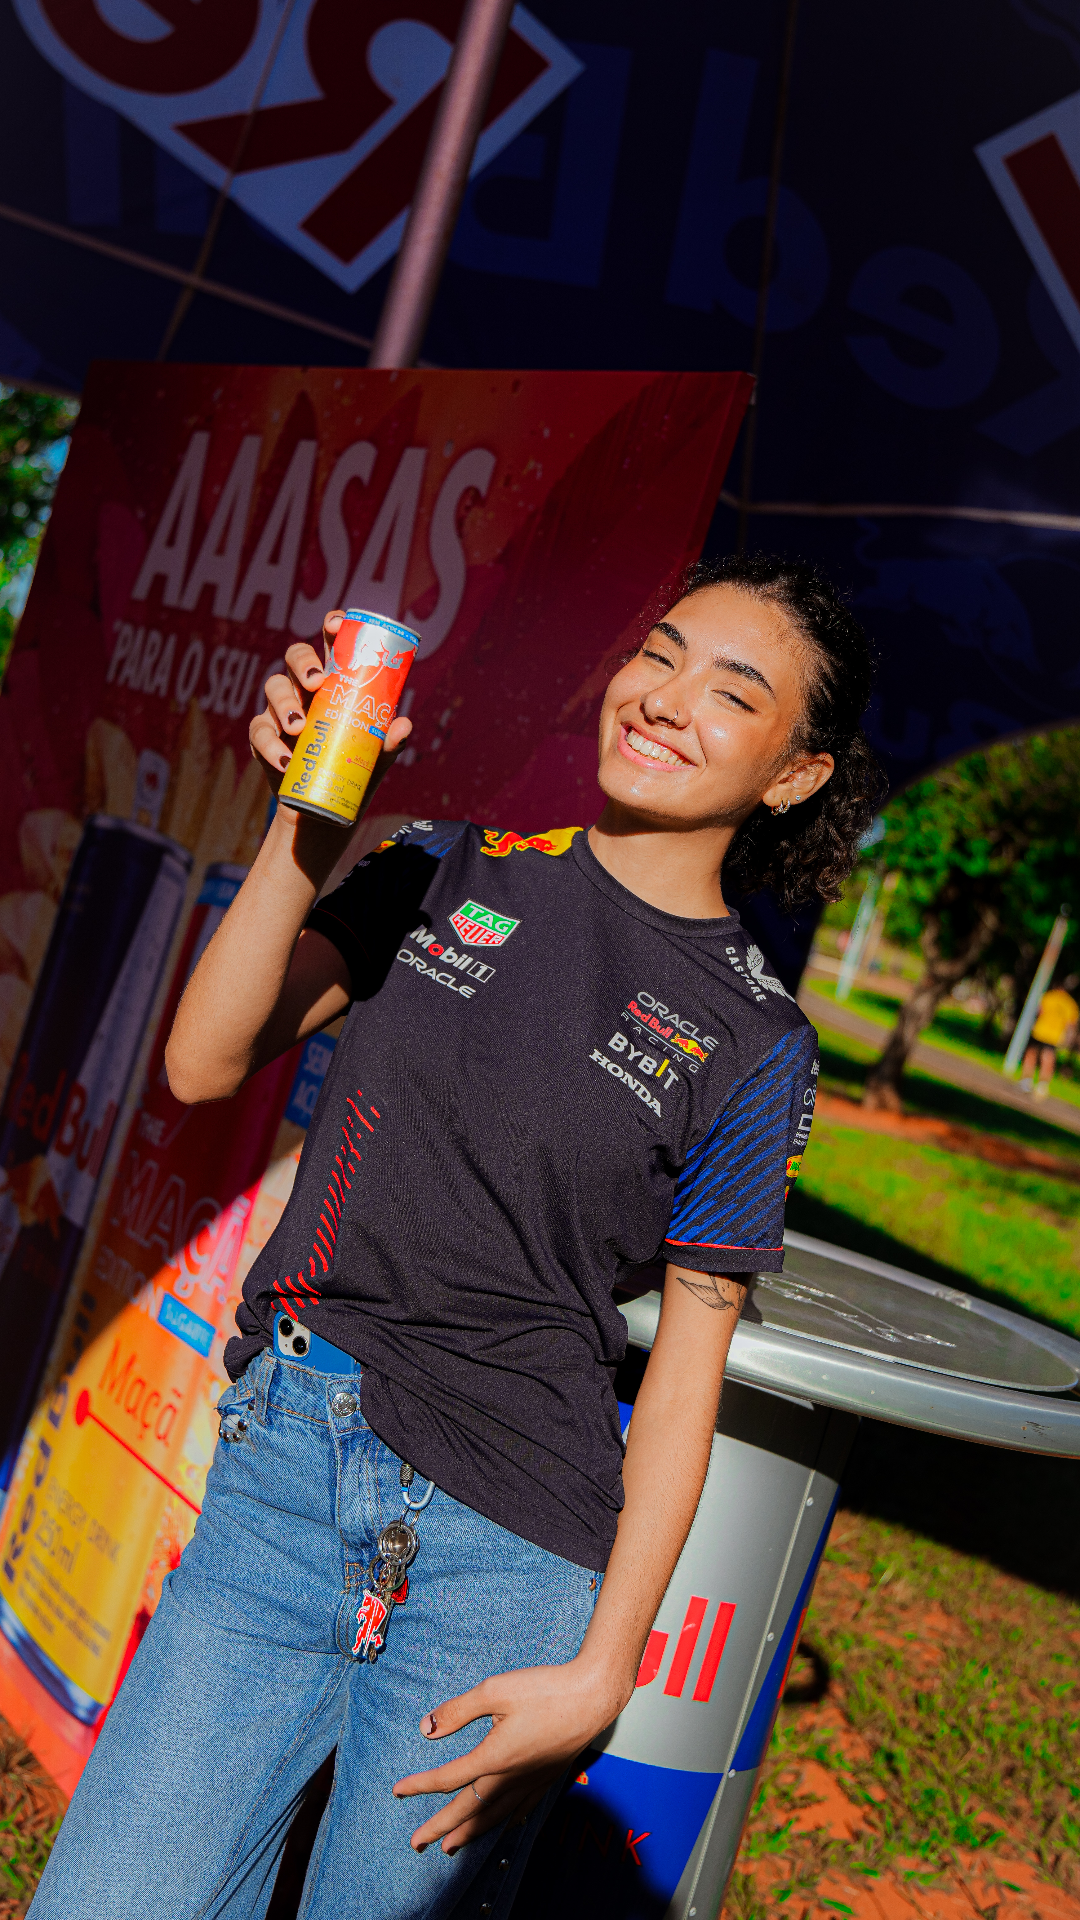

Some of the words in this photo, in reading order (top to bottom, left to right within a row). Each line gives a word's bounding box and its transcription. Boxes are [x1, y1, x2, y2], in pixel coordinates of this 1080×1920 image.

[131, 431, 497, 661] AAASAS
[198, 643, 262, 720] SEU
[339, 674, 359, 687] THE
[324, 708, 370, 733] EDITION
[290, 757, 316, 796] Red
[305, 719, 331, 758] Bull
[452, 914, 505, 945] HEUER
[468, 904, 510, 932] TAG
[397, 948, 477, 999] ORACLE
[409, 924, 474, 971] Mobil
[725, 946, 767, 1002] CASTORE
[621, 1011, 700, 1073] RACING
[627, 1000, 651, 1024] Red
[648, 1014, 674, 1039] Bull
[637, 991, 719, 1052] ORACLE
[589, 1048, 663, 1118] HONDA
[607, 1031, 679, 1090] BYBIT
[137, 1111, 166, 1147] THE
[97, 1337, 183, 1448] Maçã
